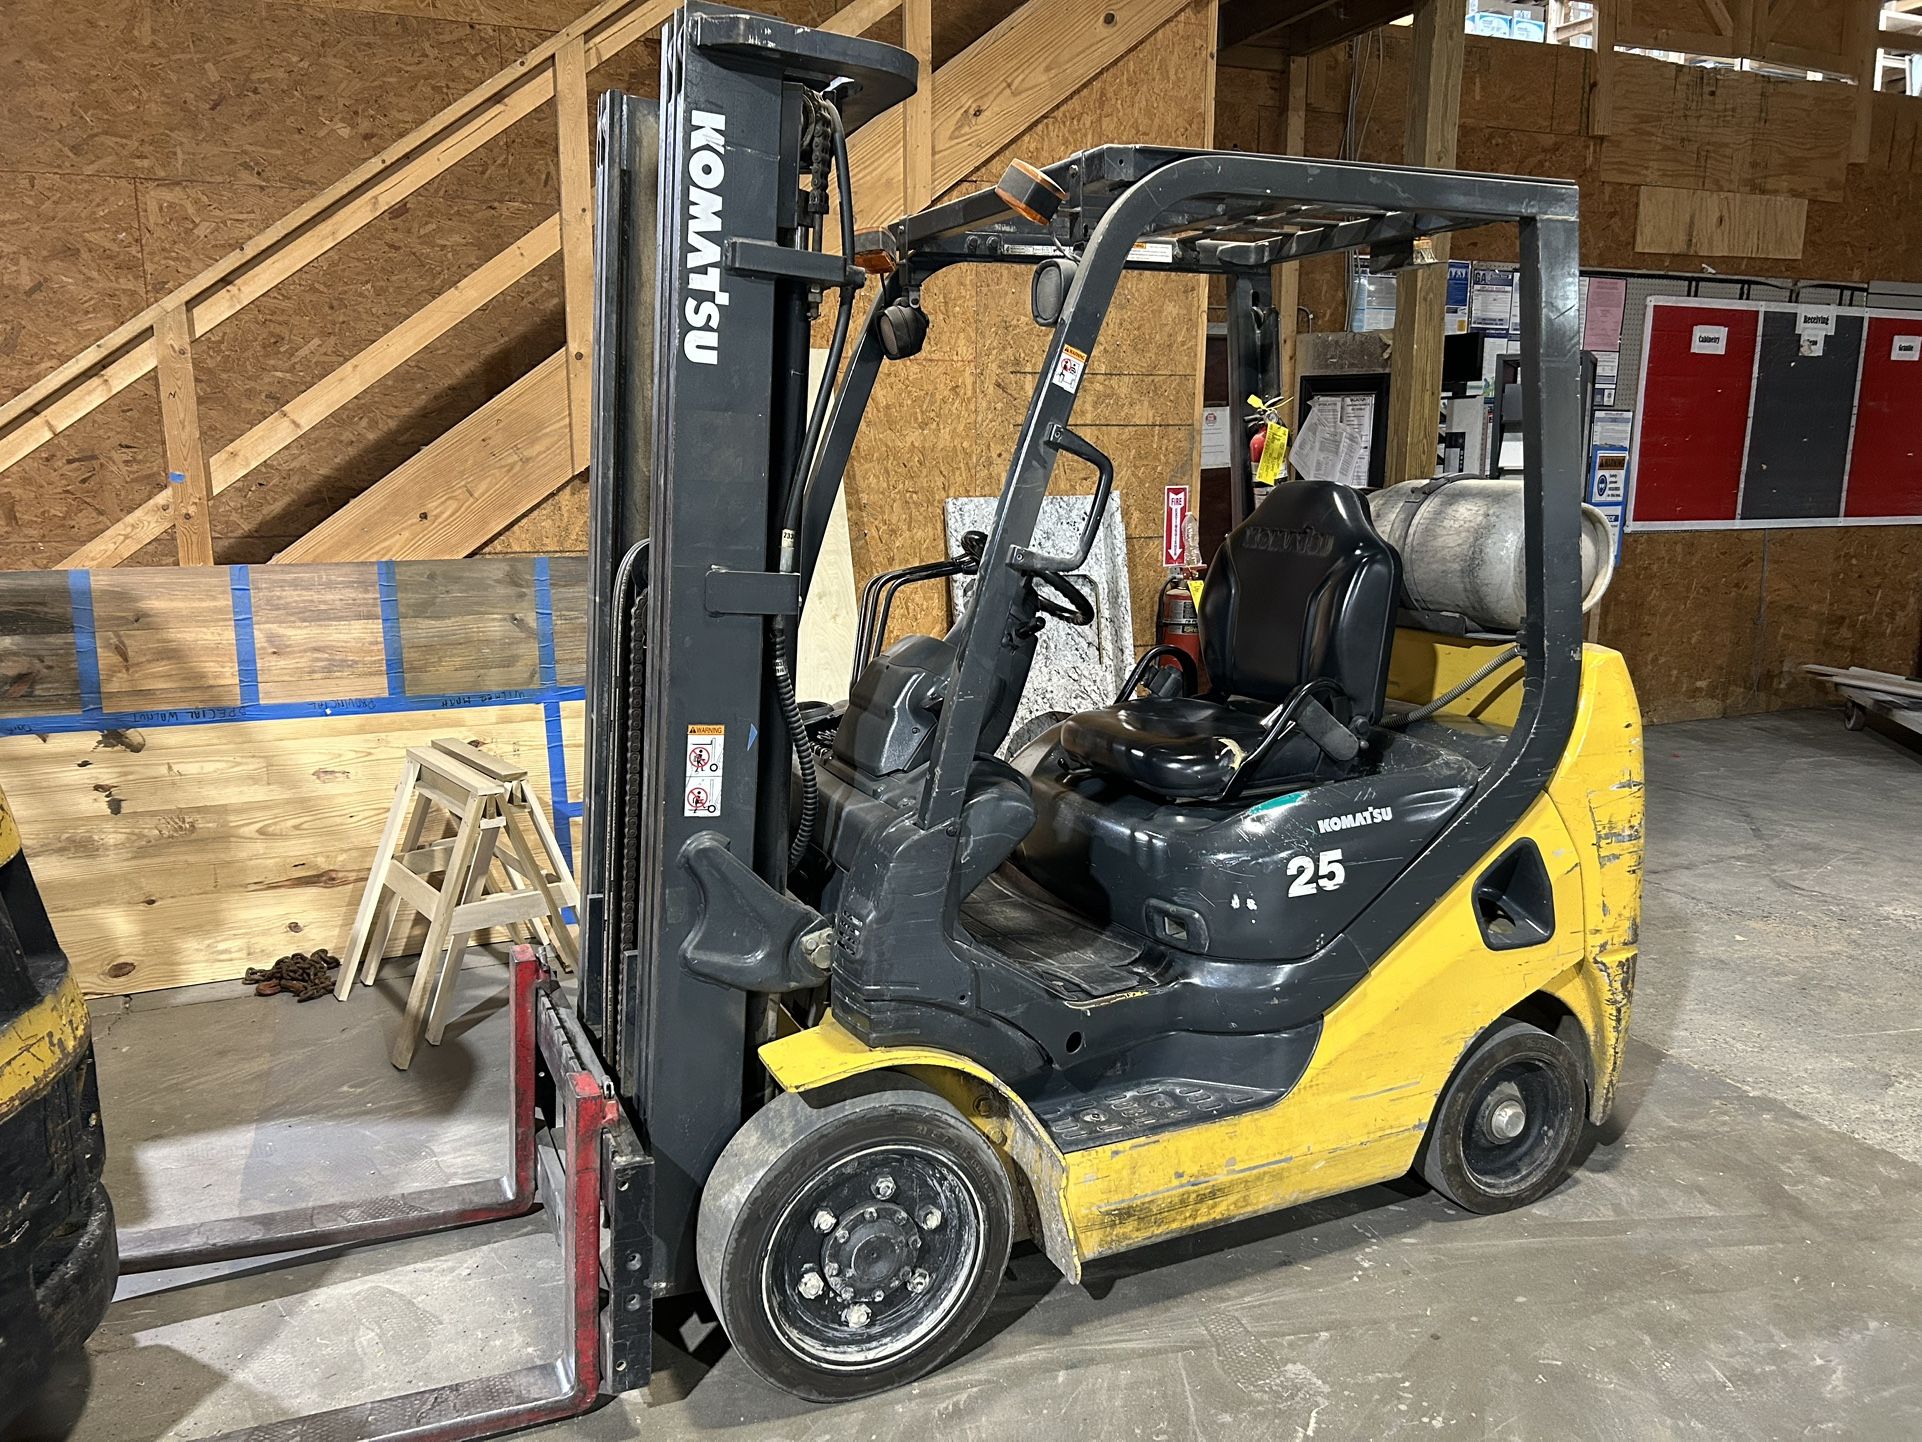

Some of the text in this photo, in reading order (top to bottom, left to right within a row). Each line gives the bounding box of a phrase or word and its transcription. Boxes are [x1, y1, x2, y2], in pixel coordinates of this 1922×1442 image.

[684, 109, 730, 366] KOMATSU
[1475, 272, 1487, 284] GA
[1803, 315, 1829, 326] Receiving
[1171, 497, 1182, 506] FIRE
[1242, 523, 1335, 558] KOMATSU
[696, 726, 722, 734] WARNING
[1317, 806, 1393, 834] KOMATSU
[1286, 848, 1346, 898] 25
